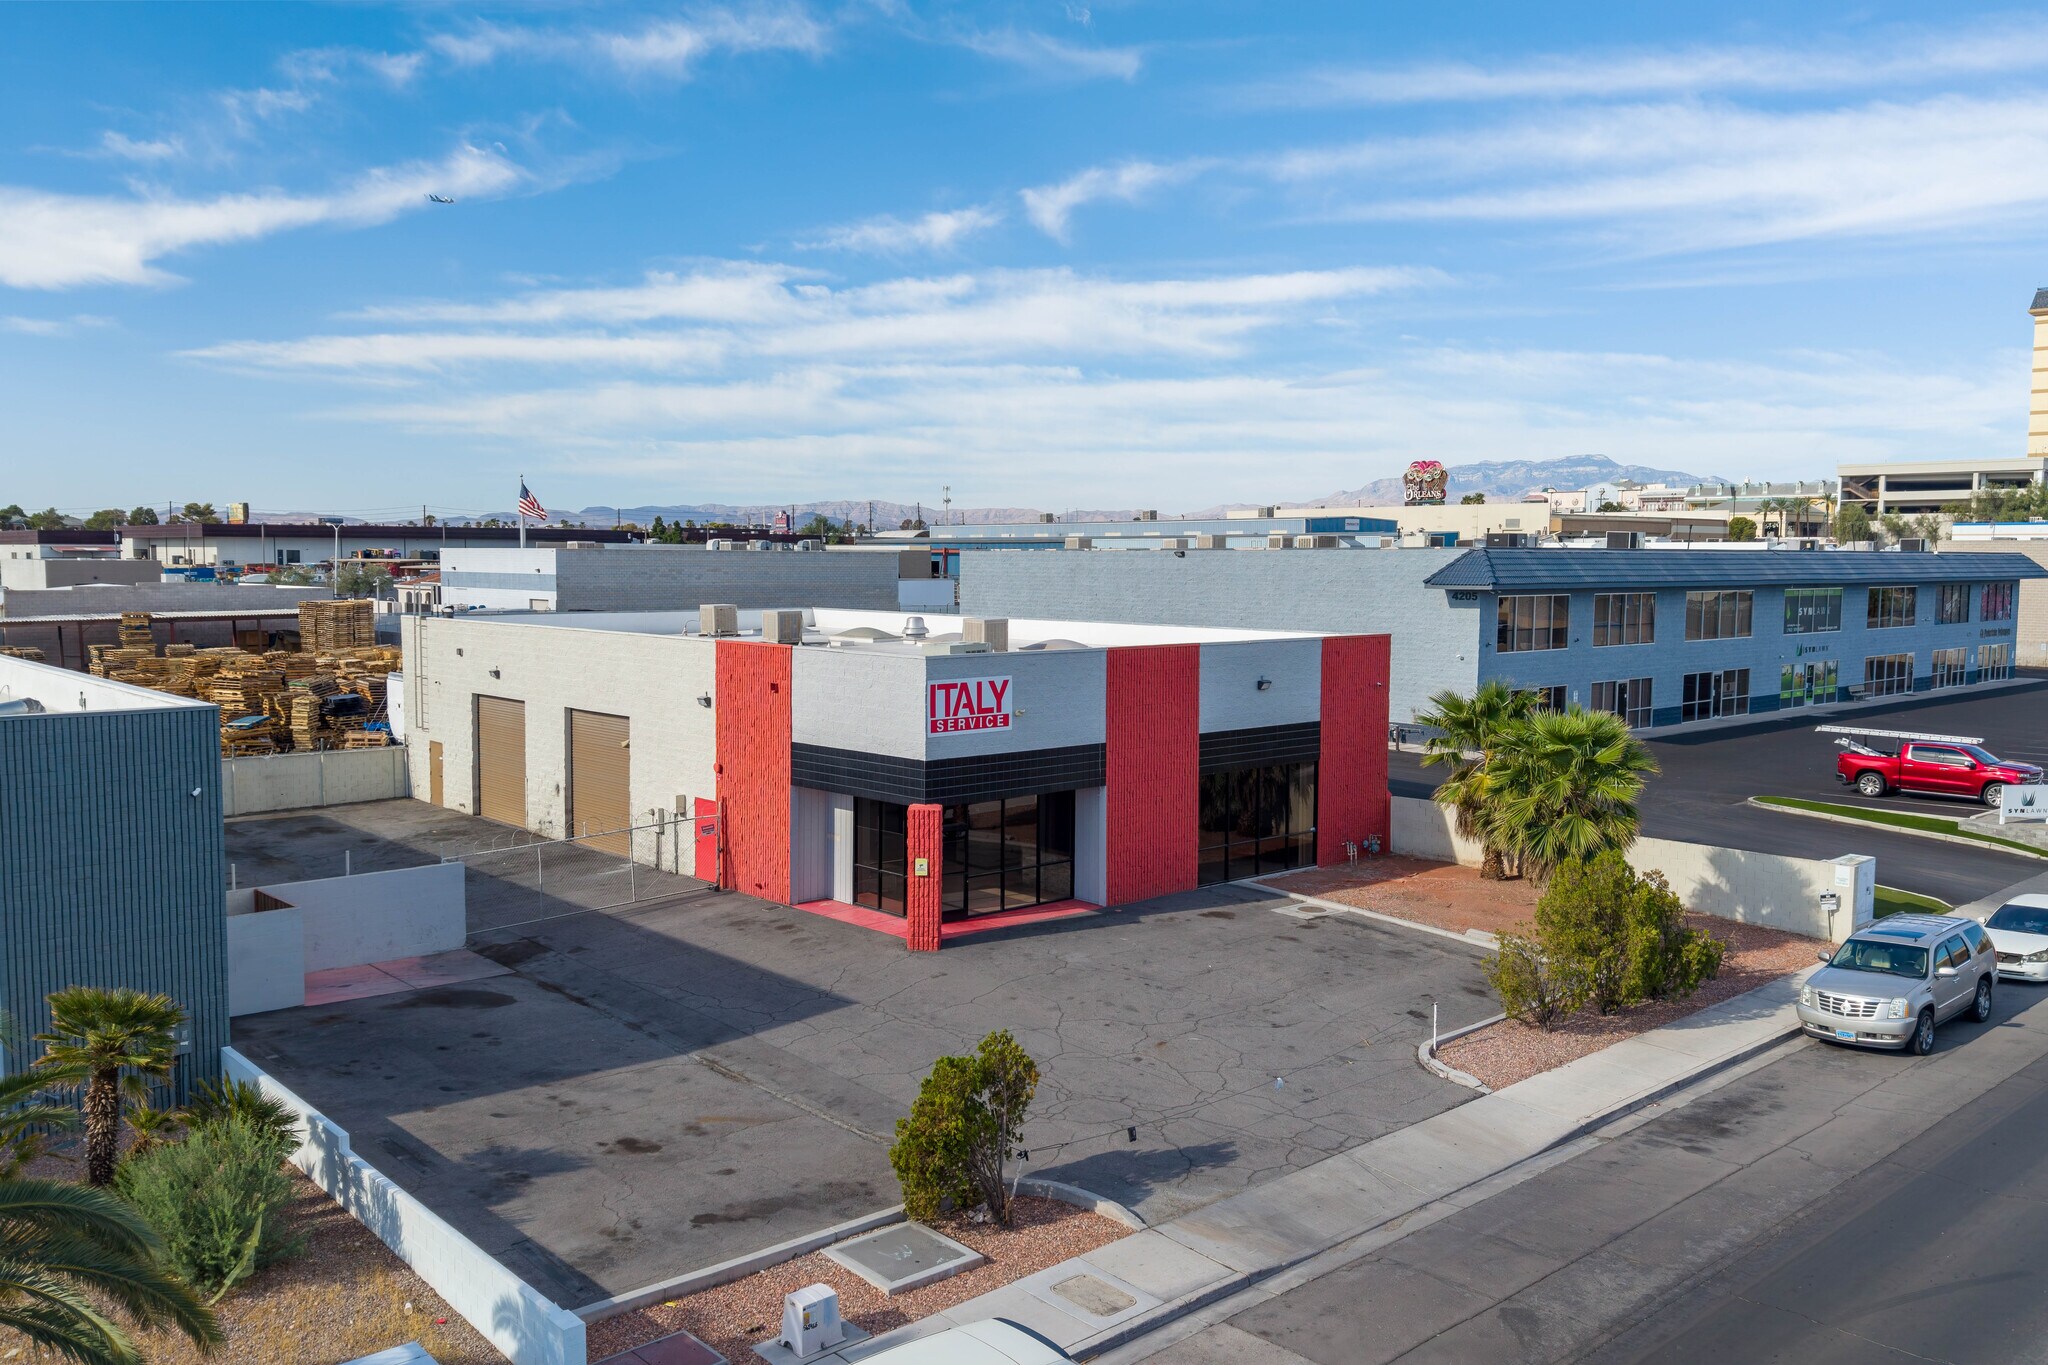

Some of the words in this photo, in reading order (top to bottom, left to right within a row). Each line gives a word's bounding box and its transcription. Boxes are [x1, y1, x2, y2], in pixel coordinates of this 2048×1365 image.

[1404, 489, 1441, 500] ORLEANS
[1452, 592, 1478, 600] 4205
[930, 680, 1010, 718] ITALY
[936, 715, 1004, 732] SERVICE
